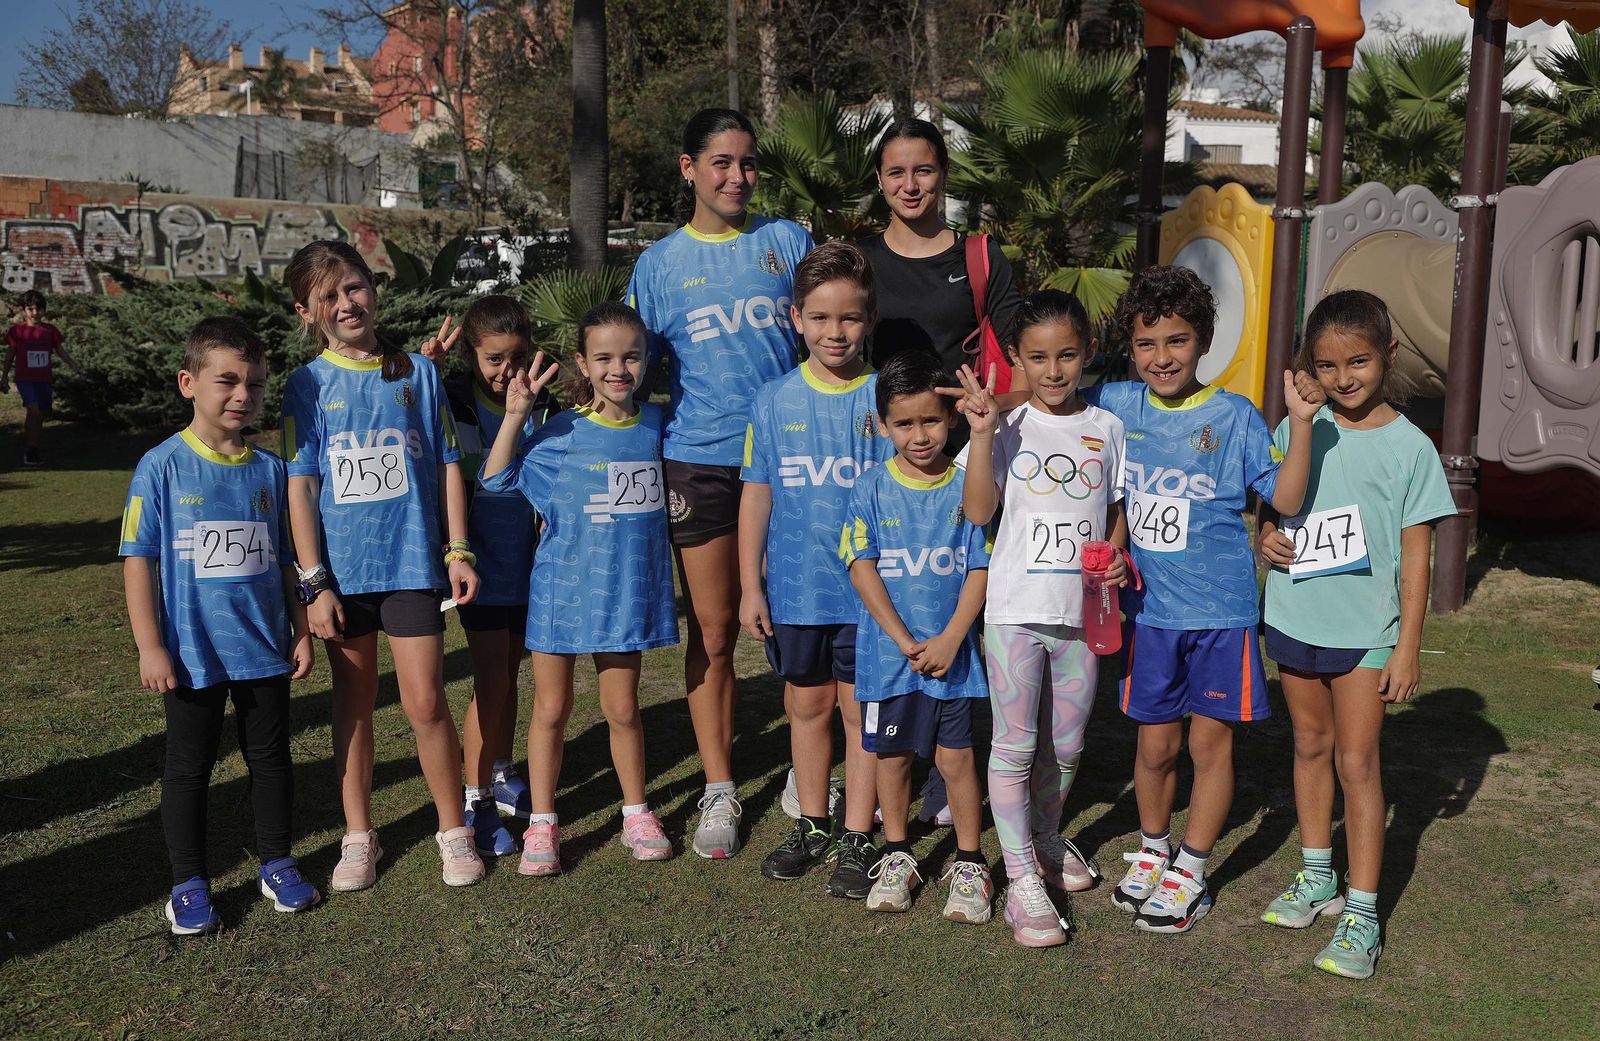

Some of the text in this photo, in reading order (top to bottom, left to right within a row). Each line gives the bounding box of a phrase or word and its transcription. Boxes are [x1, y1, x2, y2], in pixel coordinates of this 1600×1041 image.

[682, 276, 707, 289] vive
[783, 421, 808, 432] vive
[338, 453, 404, 498] 258
[588, 460, 609, 471] viv
[779, 455, 880, 488] EVO
[180, 494, 205, 505] vive
[614, 467, 661, 507] 253
[880, 517, 902, 527] vive
[1132, 501, 1181, 544] 248
[1293, 513, 1355, 564] 247
[203, 526, 264, 568] 254
[1033, 519, 1092, 564] 259
[877, 545, 967, 578] EVOS
